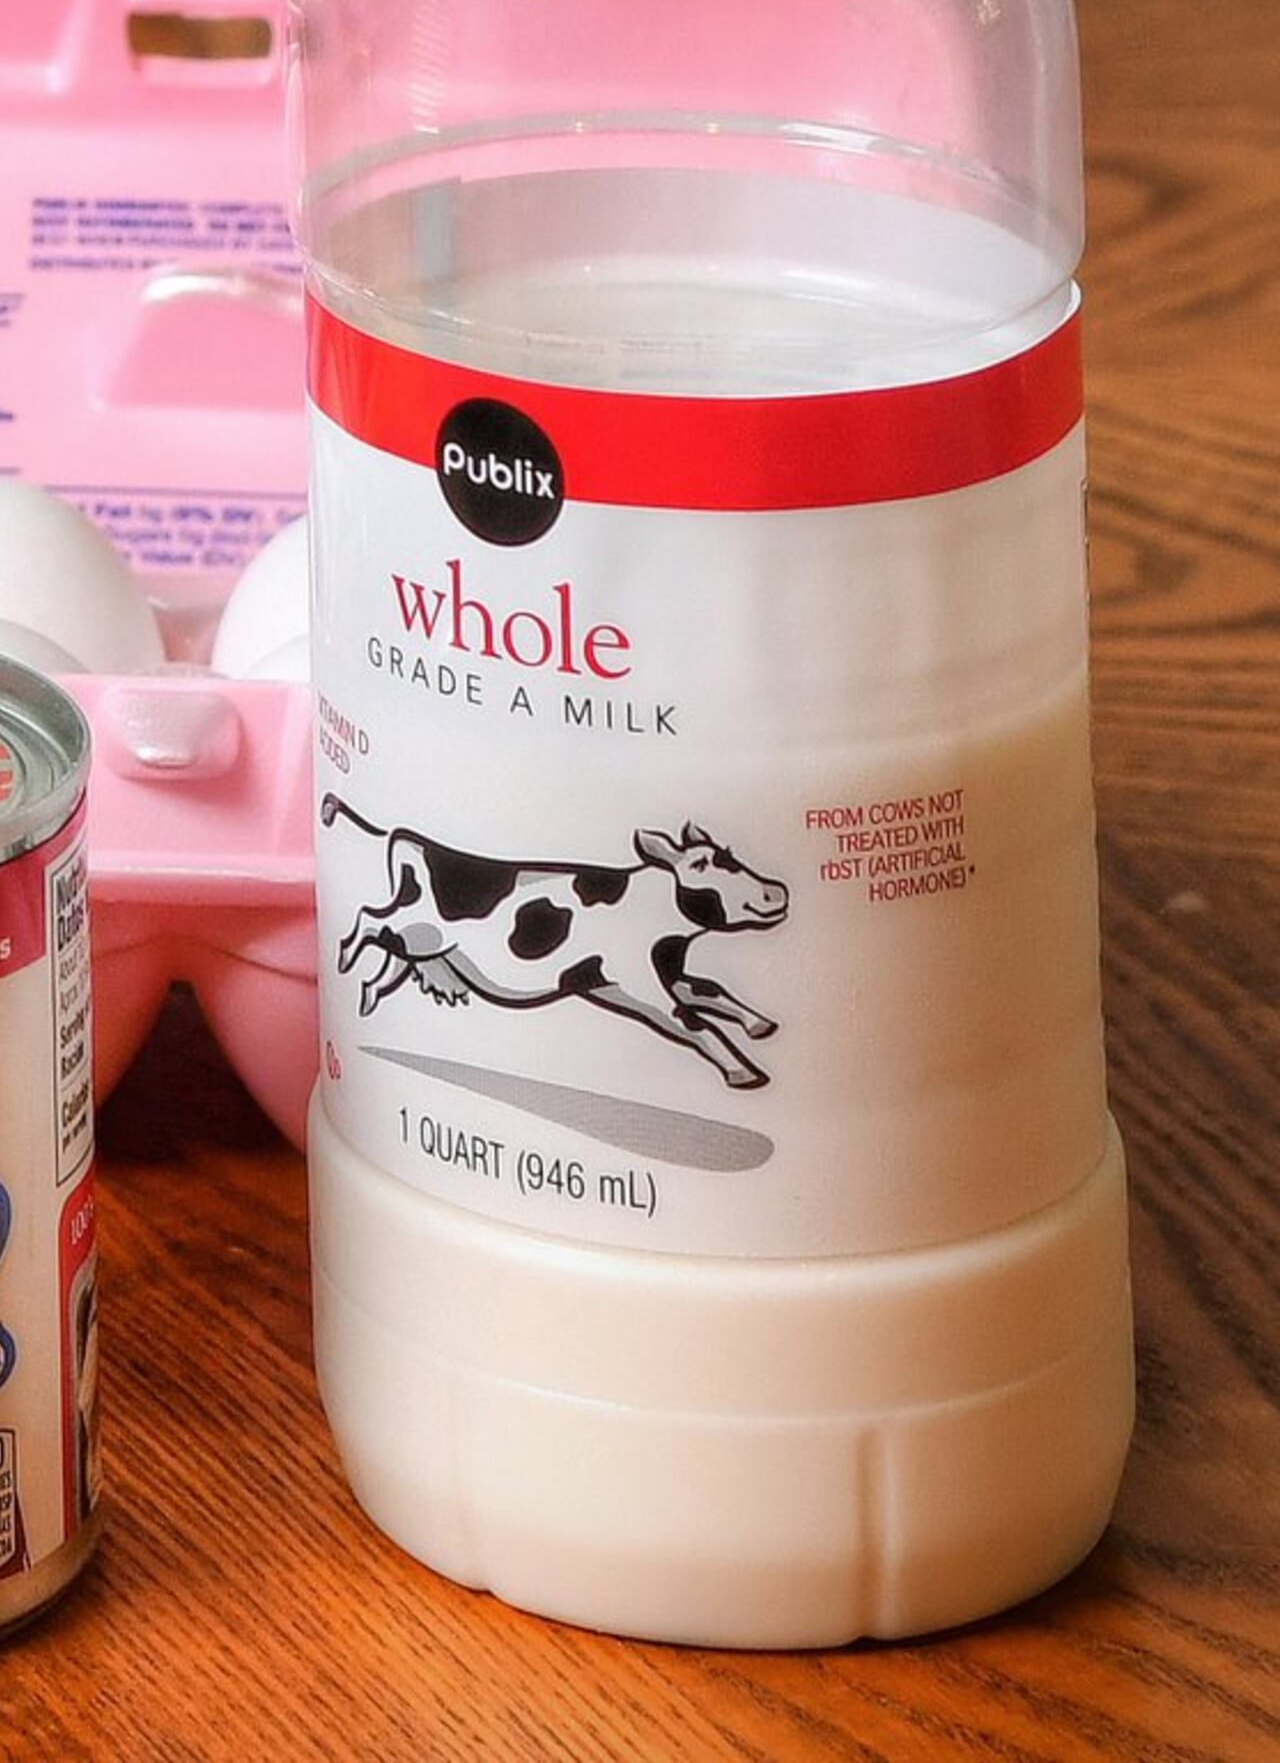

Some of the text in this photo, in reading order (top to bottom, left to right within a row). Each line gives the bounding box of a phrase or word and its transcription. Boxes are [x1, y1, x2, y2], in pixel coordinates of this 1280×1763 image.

[442, 441, 555, 501] Publix
[391, 559, 633, 681] whole
[367, 636, 679, 737] GRADE A MILK
[805, 789, 964, 829] FROM COWS NOT
[837, 815, 965, 853] TREATED WITH
[820, 842, 966, 881] rbST (ARTIFICIAL
[399, 1106, 659, 1219] 1 QUART (946 mL)
